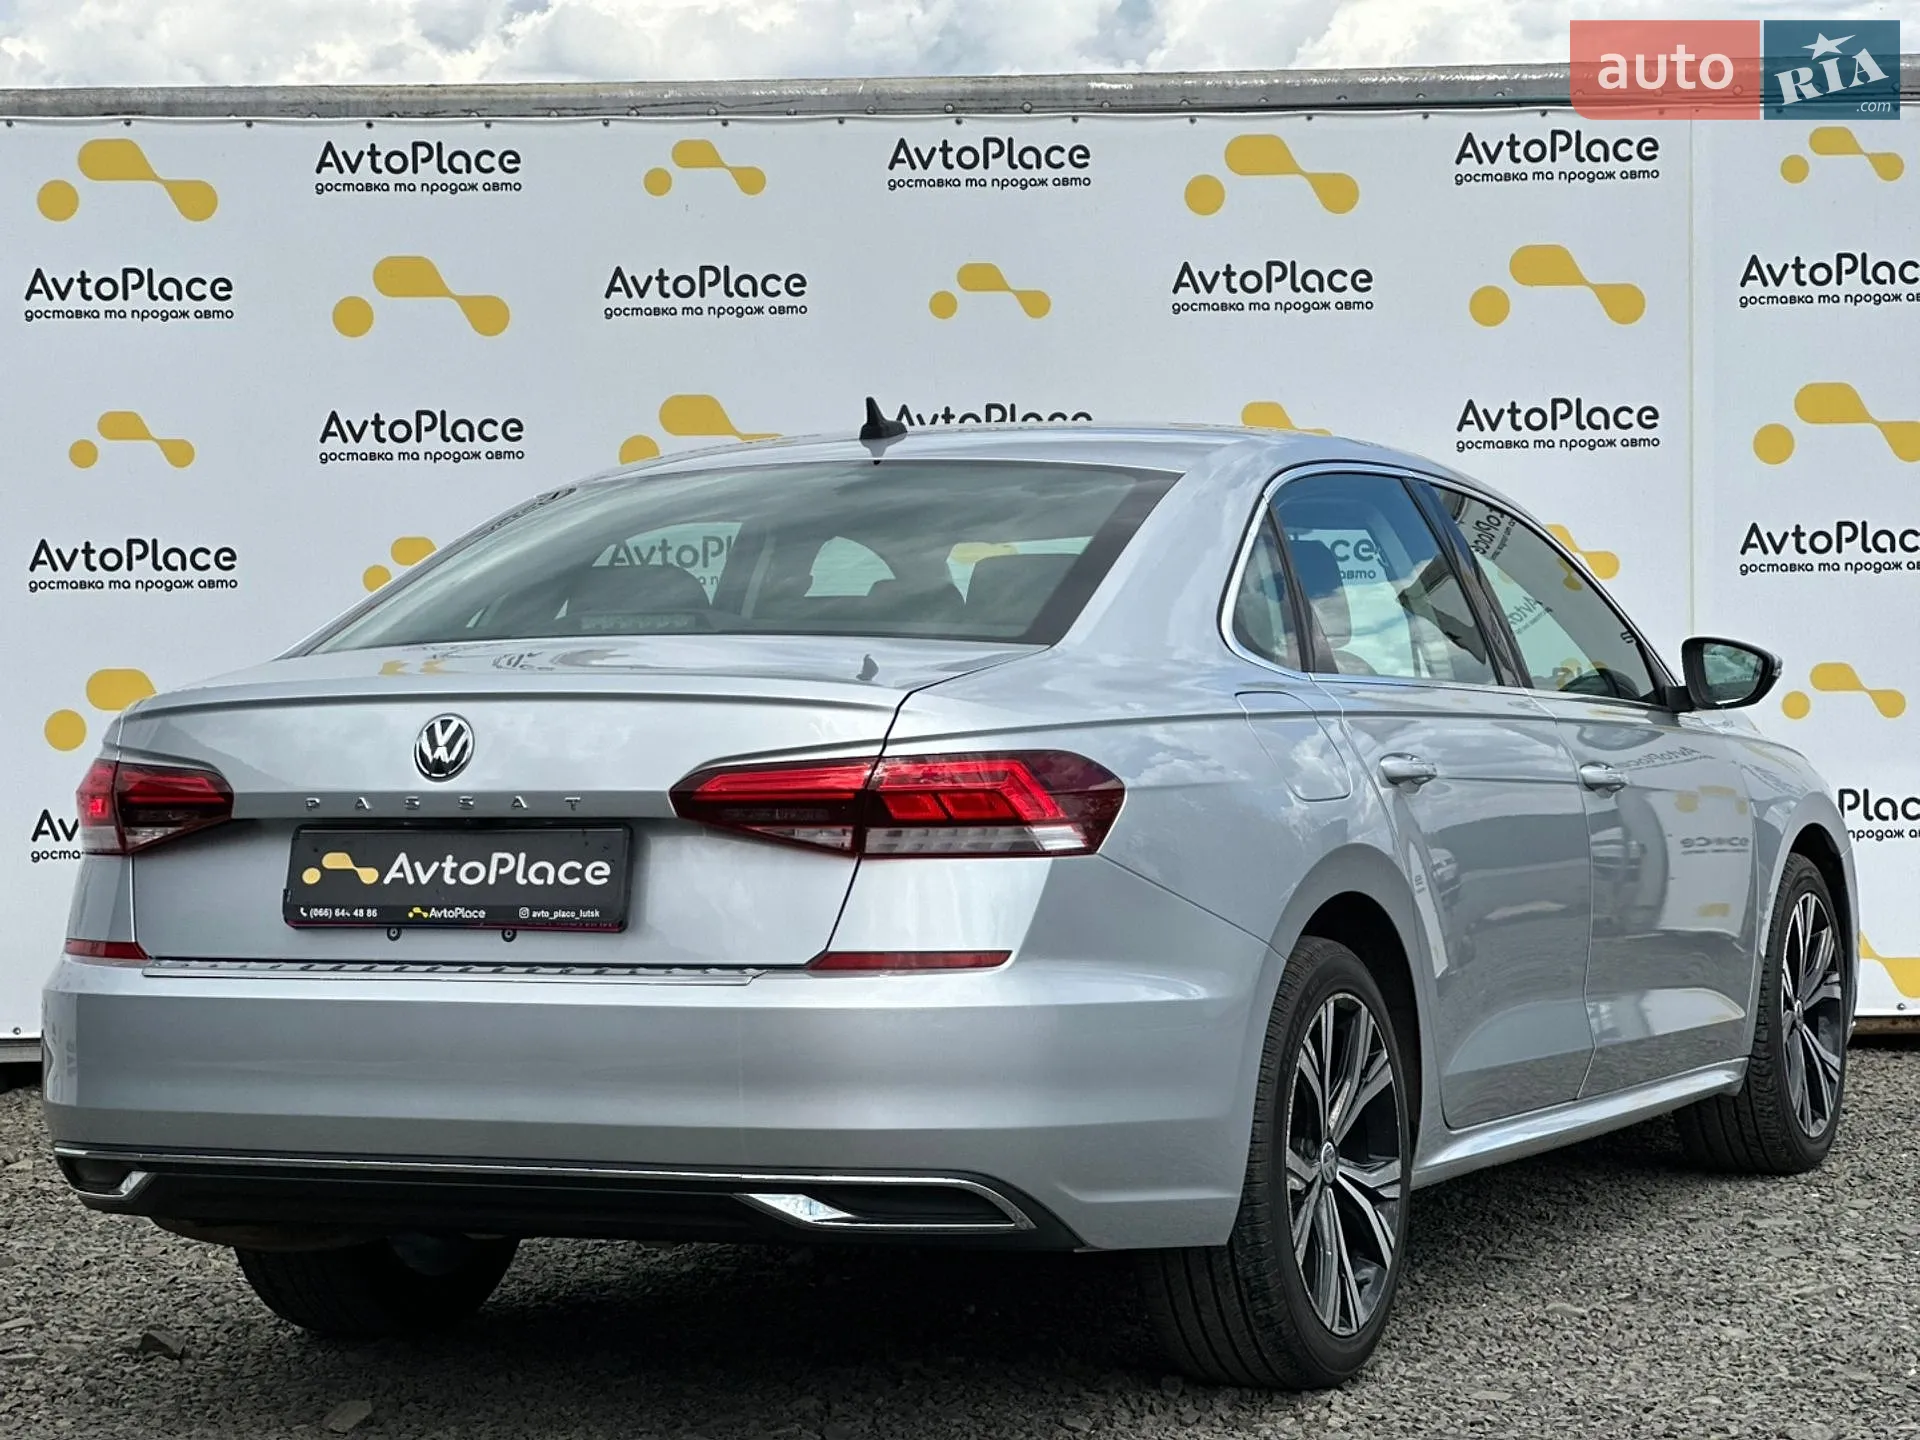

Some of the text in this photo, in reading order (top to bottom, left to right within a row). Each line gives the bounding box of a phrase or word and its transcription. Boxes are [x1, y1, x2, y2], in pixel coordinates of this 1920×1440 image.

[888, 136, 1091, 171] AvtoPlace
[1455, 130, 1659, 166] AvtoPlace
[315, 140, 522, 175] AvtoPlace
[887, 176, 1092, 192] доставка та продаж авто
[1454, 169, 1660, 185] доставка та продаж авто
[314, 181, 523, 196] доставка та продаж авто
[1171, 260, 1374, 295] AvtoPlace
[1739, 251, 1920, 288] AvtoPlac
[25, 267, 233, 302] AvtoPlace
[605, 265, 807, 300] AvtoPlace
[1171, 300, 1374, 315] доставка та продаж авто
[1738, 294, 1814, 309] доставка
[1817, 294, 1841, 304] та
[1844, 292, 1903, 307] продаж
[24, 309, 235, 323] доставка та продаж авто
[603, 304, 808, 319] доставка та продаж авто
[1456, 397, 1660, 433] AvtoPlace
[319, 409, 524, 444] AvtoPlace
[1455, 437, 1661, 452] доставка та продаж авто
[318, 450, 525, 465] доставка та продаж авто
[1740, 520, 1920, 556] AvtoPlac
[28, 537, 238, 573] AvtoPlace
[1739, 562, 1815, 577] доставка
[1817, 562, 1841, 572] та
[1844, 561, 1903, 575] продаж
[28, 578, 239, 594] доставка та продаж авто
[304, 795, 582, 811] PASSAT
[30, 850, 81, 863] доста
[383, 851, 612, 887] AvtoPlace
[429, 906, 487, 919] AvtoPlace
